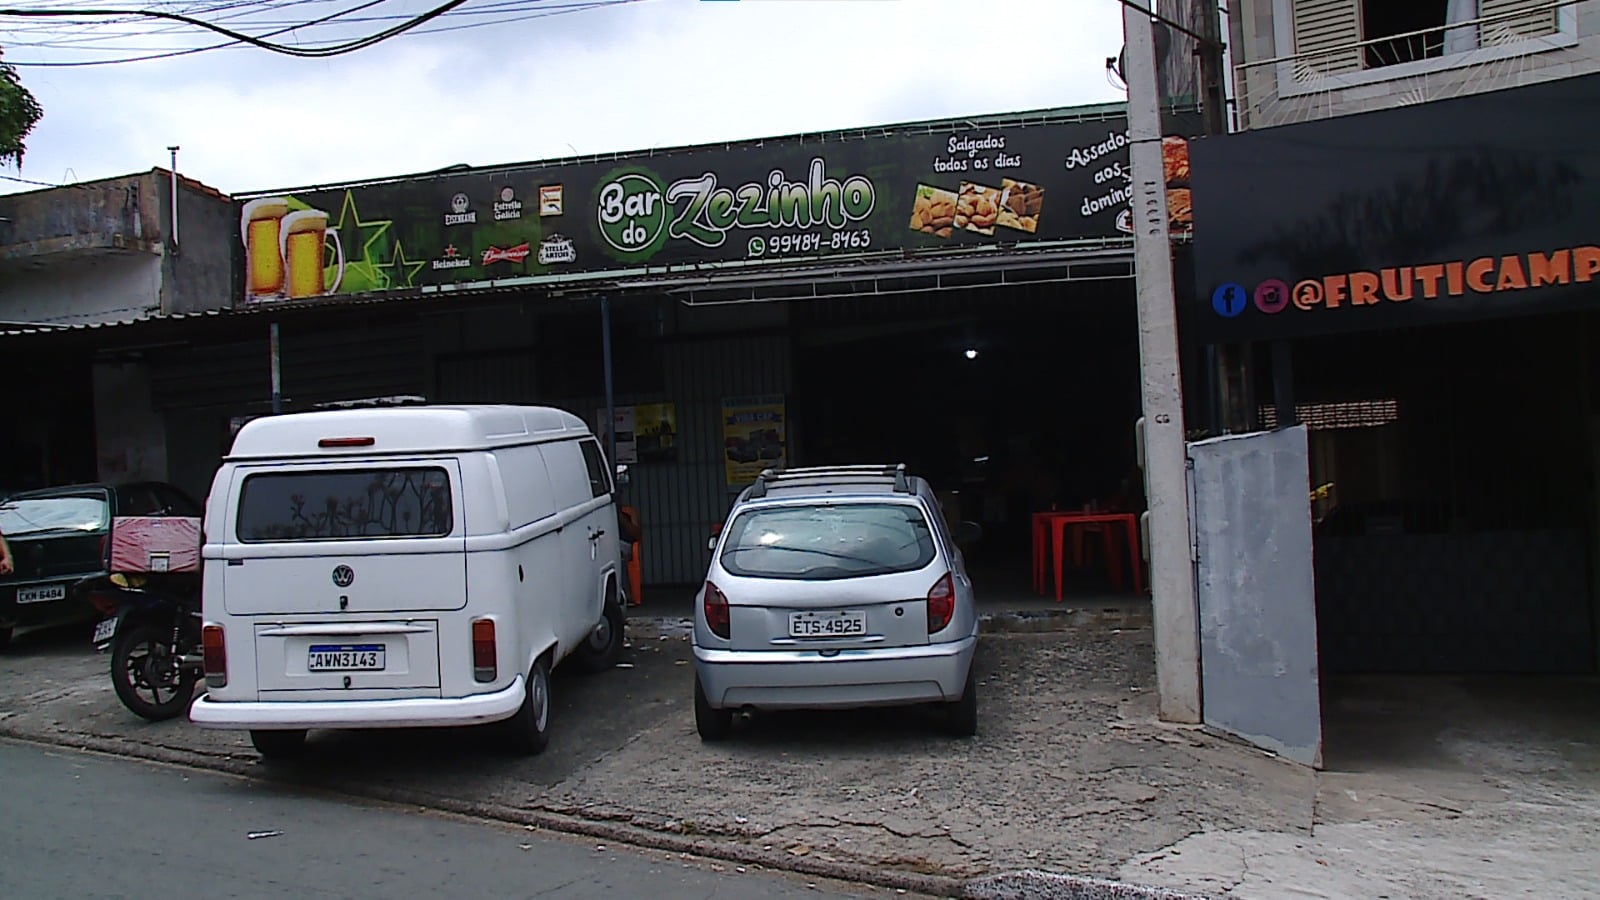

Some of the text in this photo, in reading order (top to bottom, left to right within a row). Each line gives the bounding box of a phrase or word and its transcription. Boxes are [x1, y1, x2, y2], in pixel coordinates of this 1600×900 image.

[948, 135, 1005, 157] Salgados
[1066, 129, 1131, 169] Assados
[934, 153, 1020, 173] todos os dias
[1094, 162, 1121, 184] aos
[601, 182, 661, 223] Bar
[666, 158, 875, 247] Zezinho
[1081, 183, 1134, 216] doming
[622, 220, 647, 245] do
[769, 230, 870, 254] 99484-8463
[432, 258, 471, 270] Heineken
[1292, 246, 1600, 310] @FRUTICAMP
